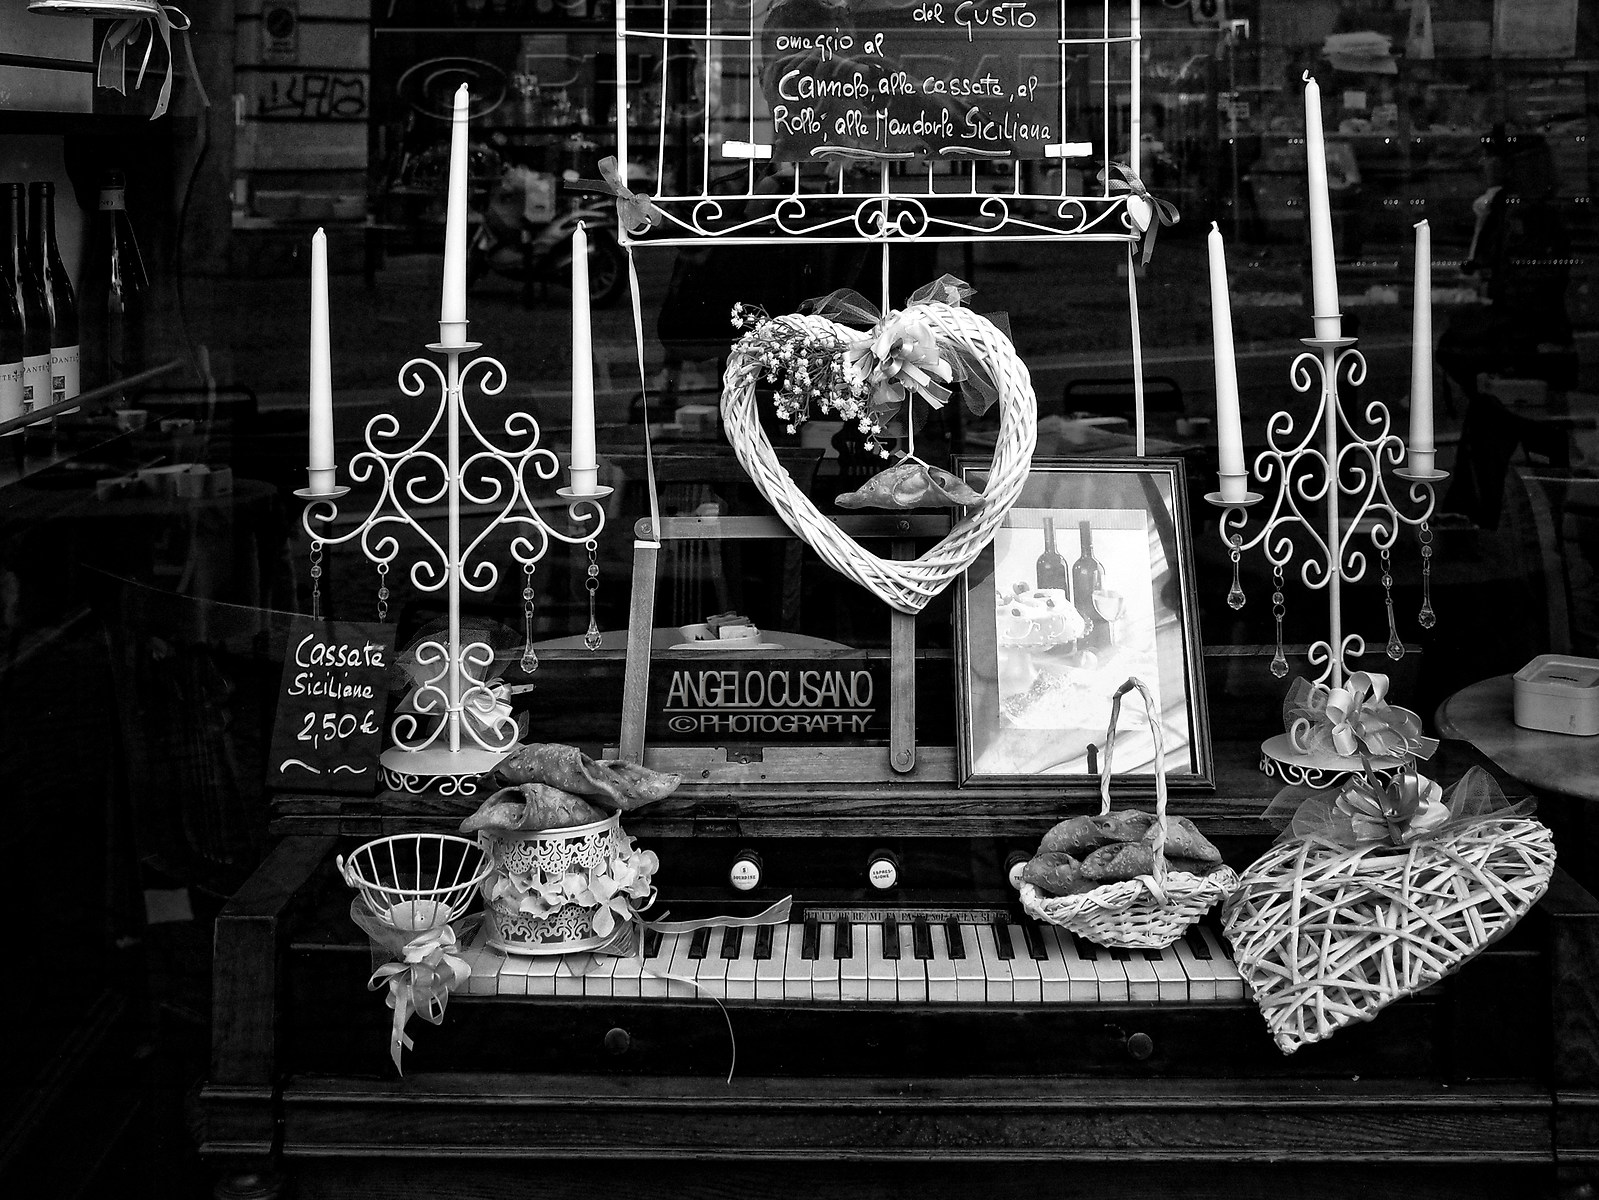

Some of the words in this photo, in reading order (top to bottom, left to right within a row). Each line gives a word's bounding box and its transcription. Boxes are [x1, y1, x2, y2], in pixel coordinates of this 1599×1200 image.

[912, 3, 945, 24] del
[864, 32, 884, 58] al
[1017, 75, 1038, 102] al
[960, 106, 1051, 142] Siciliana
